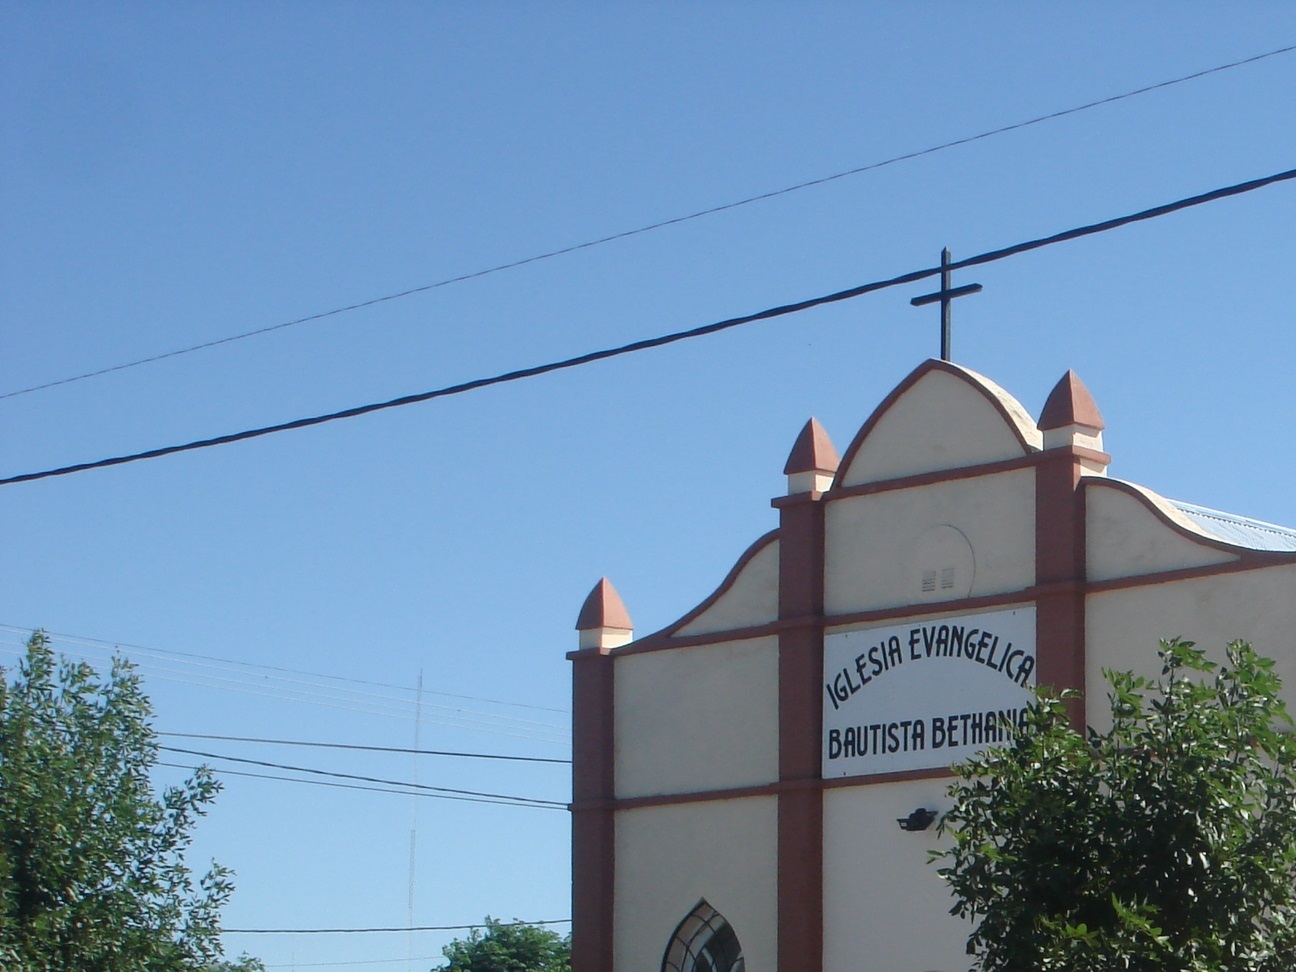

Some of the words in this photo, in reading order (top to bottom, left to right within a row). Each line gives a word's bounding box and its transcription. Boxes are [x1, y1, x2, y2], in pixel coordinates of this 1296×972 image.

[826, 635, 903, 710] IGLESIA
[908, 625, 1035, 688] EVANGELICA
[828, 719, 925, 760] BAUTISTA
[931, 706, 1031, 749] BETHANIA
